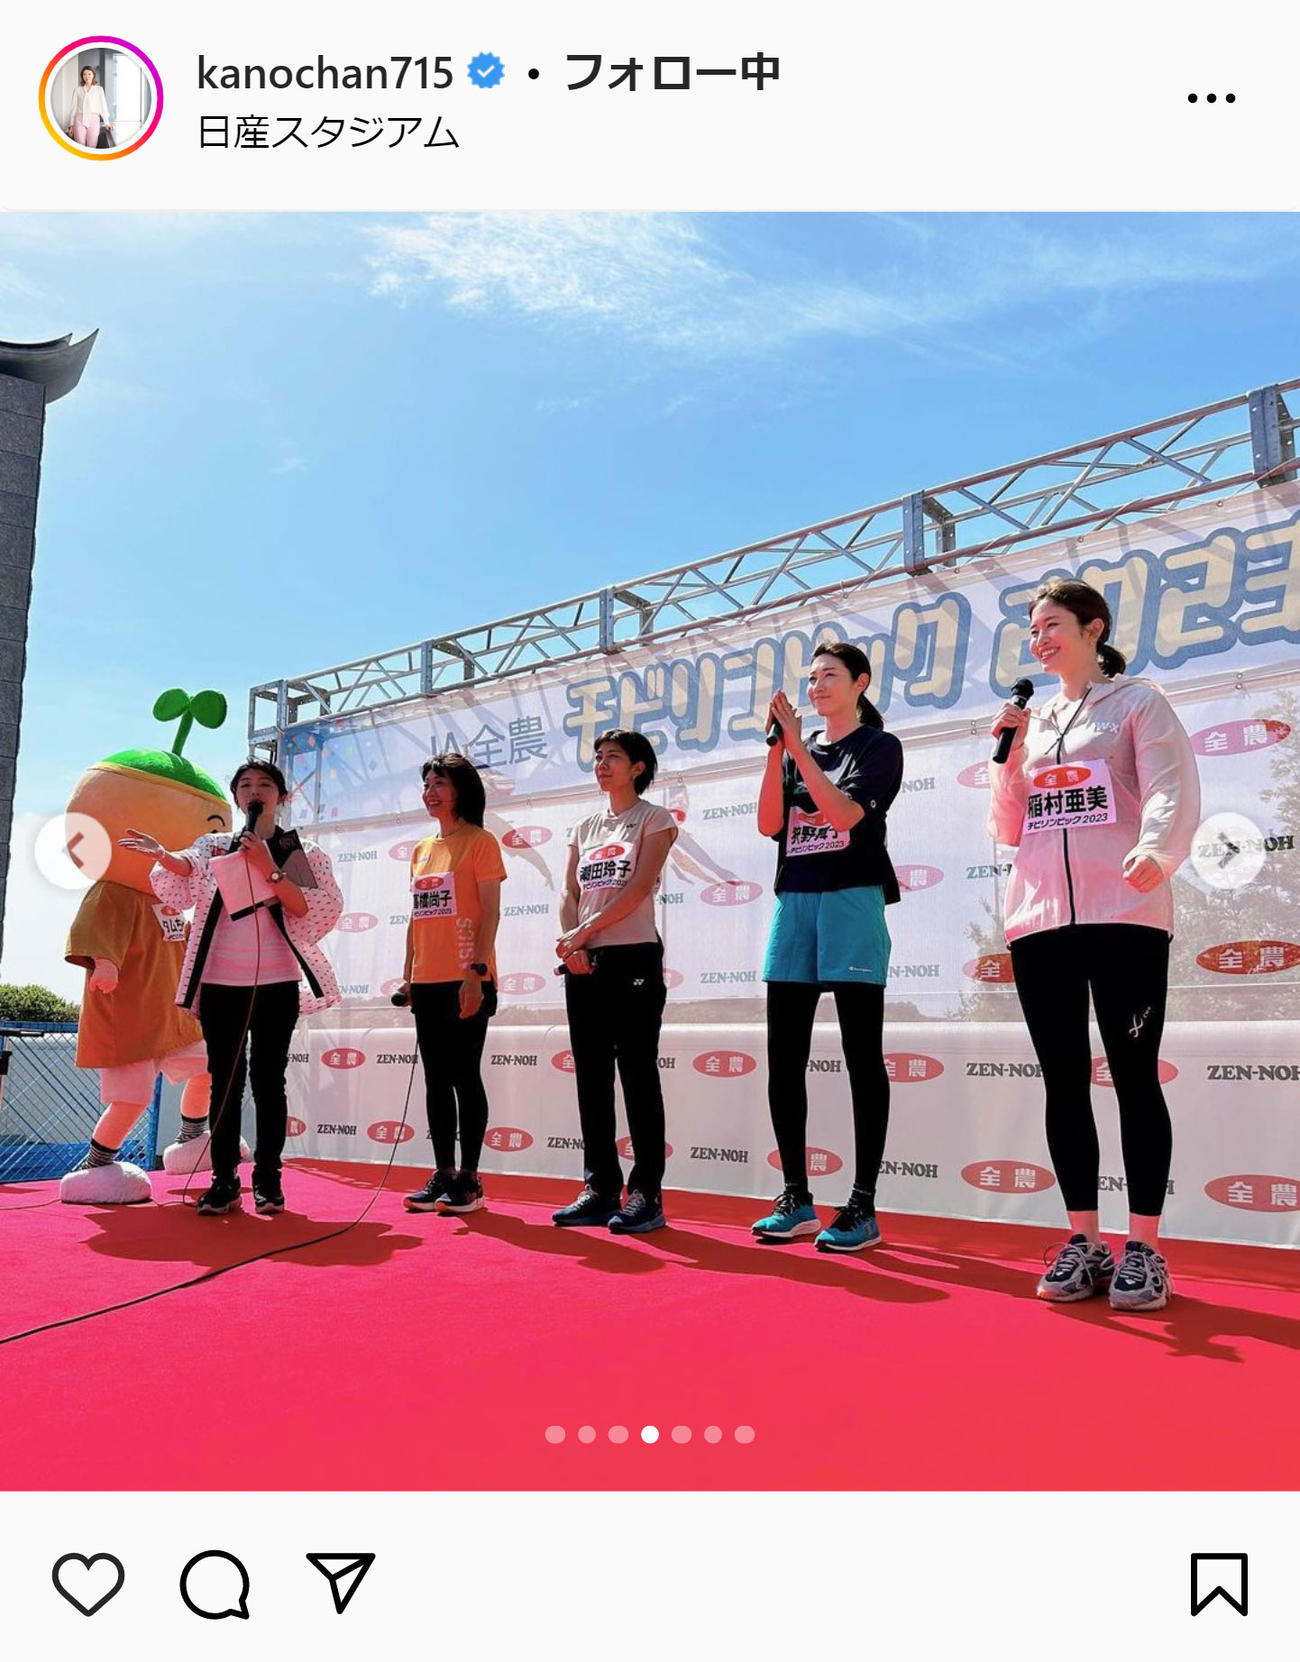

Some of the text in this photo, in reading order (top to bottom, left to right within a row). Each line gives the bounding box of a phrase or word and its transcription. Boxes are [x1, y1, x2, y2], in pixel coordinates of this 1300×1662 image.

[1203, 724, 1268, 752] 全農
[1028, 785, 1108, 819] 稲村亜美
[703, 803, 757, 820] ZEN-NOH
[337, 851, 378, 863] ZEN-NOH
[504, 904, 550, 917] ZEN-NOH
[1218, 948, 1284, 969] 全農
[700, 971, 757, 985] ZEN-NOH
[376, 1054, 418, 1065] ZEN-NOH
[491, 1054, 538, 1067] ZEN-NOH
[705, 1055, 744, 1073] 全農
[317, 1123, 357, 1136] ZEN-NOH
[491, 1131, 523, 1147] 全農
[690, 1146, 749, 1164] ZEN-NOH
[979, 1165, 1036, 1188] 全農
[1227, 1181, 1297, 1207] 全農
